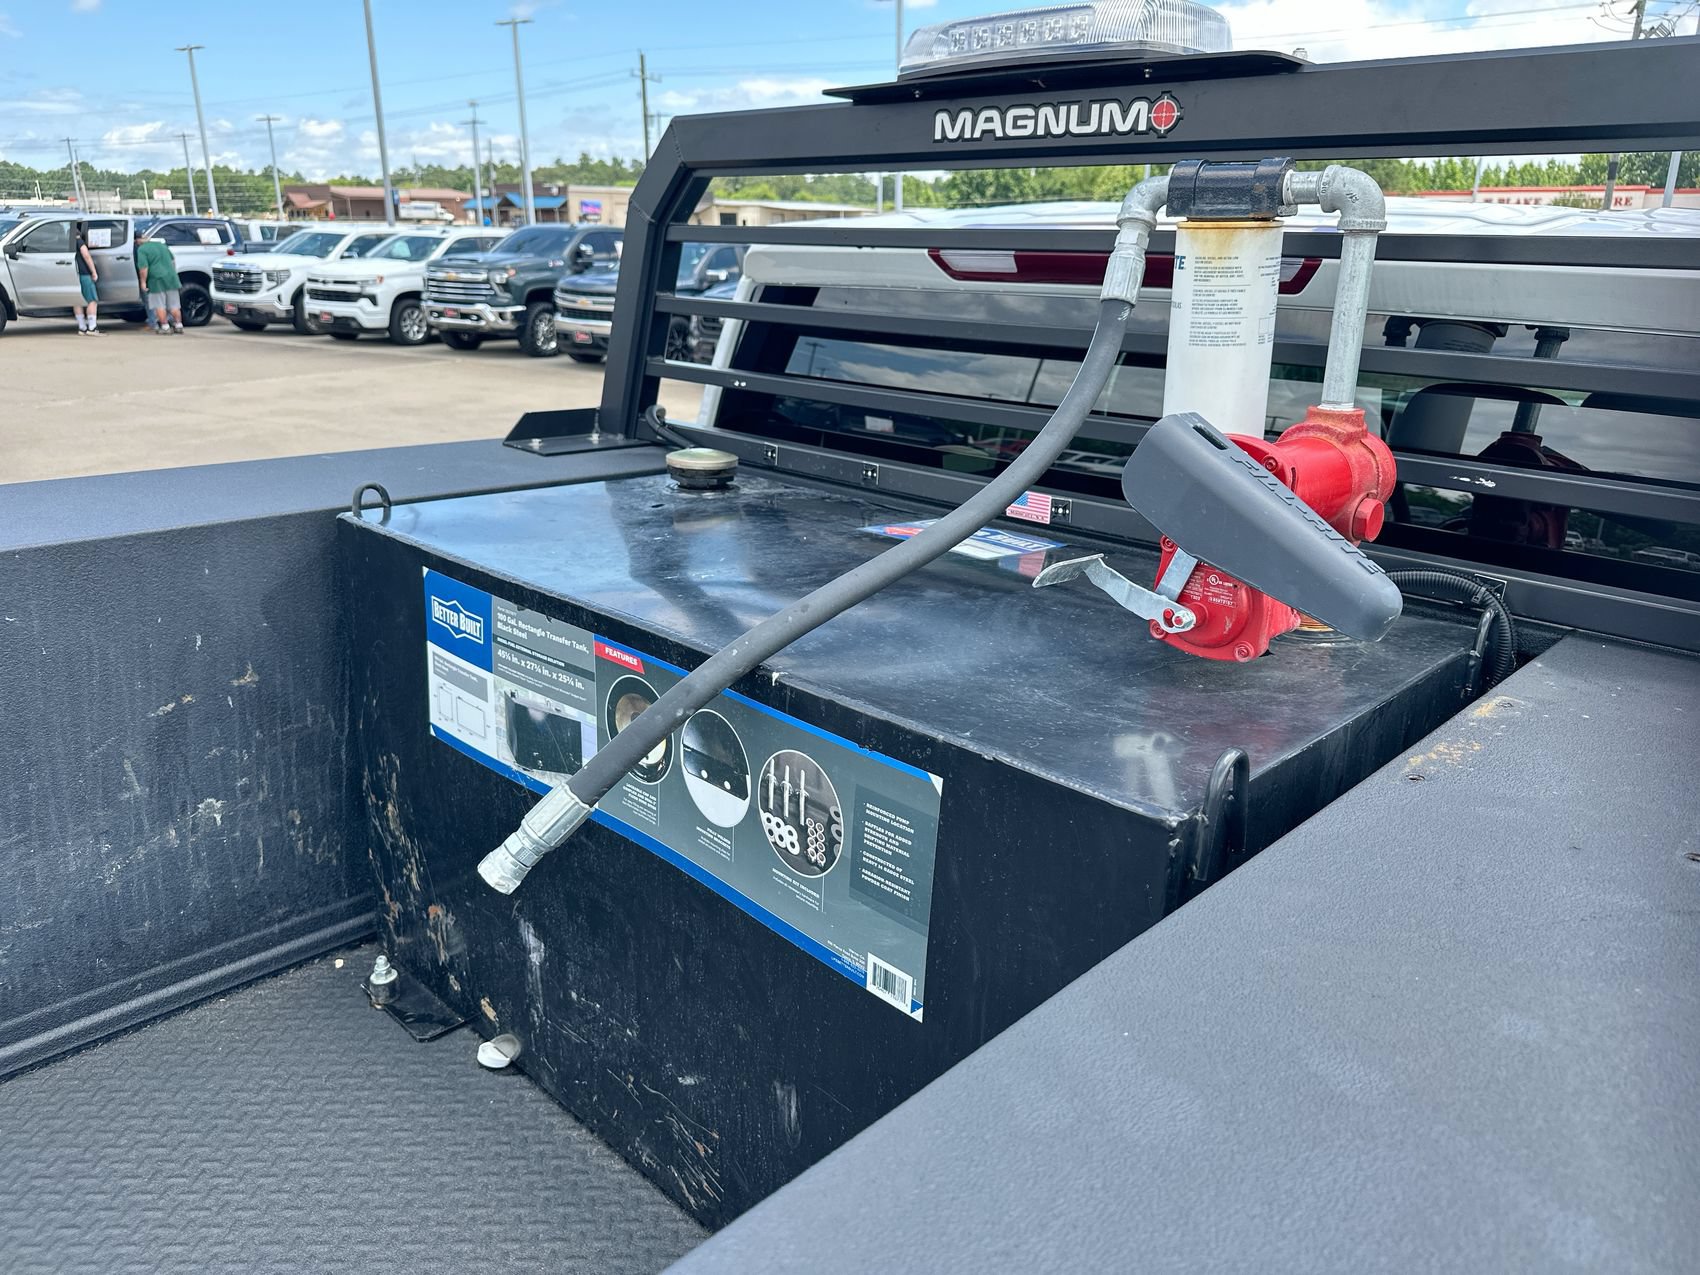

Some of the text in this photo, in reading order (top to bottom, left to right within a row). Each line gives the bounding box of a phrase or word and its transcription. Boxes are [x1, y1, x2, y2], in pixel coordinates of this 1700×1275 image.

[934, 101, 1149, 140] MAGNUM
[995, 534, 1045, 549] BUILT
[433, 601, 459, 628] BETTER
[459, 611, 481, 637] BUILT
[497, 621, 528, 640] Black Steel
[518, 619, 546, 637] Rectangle
[546, 630, 572, 647] Transfer
[572, 640, 590, 655] Tank,
[605, 646, 638, 666] FEATURES
[512, 654, 520, 665] in.
[542, 666, 551, 678] in.
[575, 678, 585, 690] in.
[866, 803, 895, 819] REINFORCED
[866, 808, 914, 834] MOUNTING LOCATION
[864, 827, 899, 846] STRENGTH AND
[885, 830, 895, 838] FOR
[895, 835, 912, 845] ADDED
[863, 839, 892, 856] PREVENTION
[886, 843, 910, 858] MATERIAL
[862, 850, 895, 869] CONSTRUCTED
[862, 856, 878, 867] HEAVY
[900, 874, 915, 885] STEEL
[861, 874, 880, 887] POWDER
[880, 883, 893, 893] COAT
